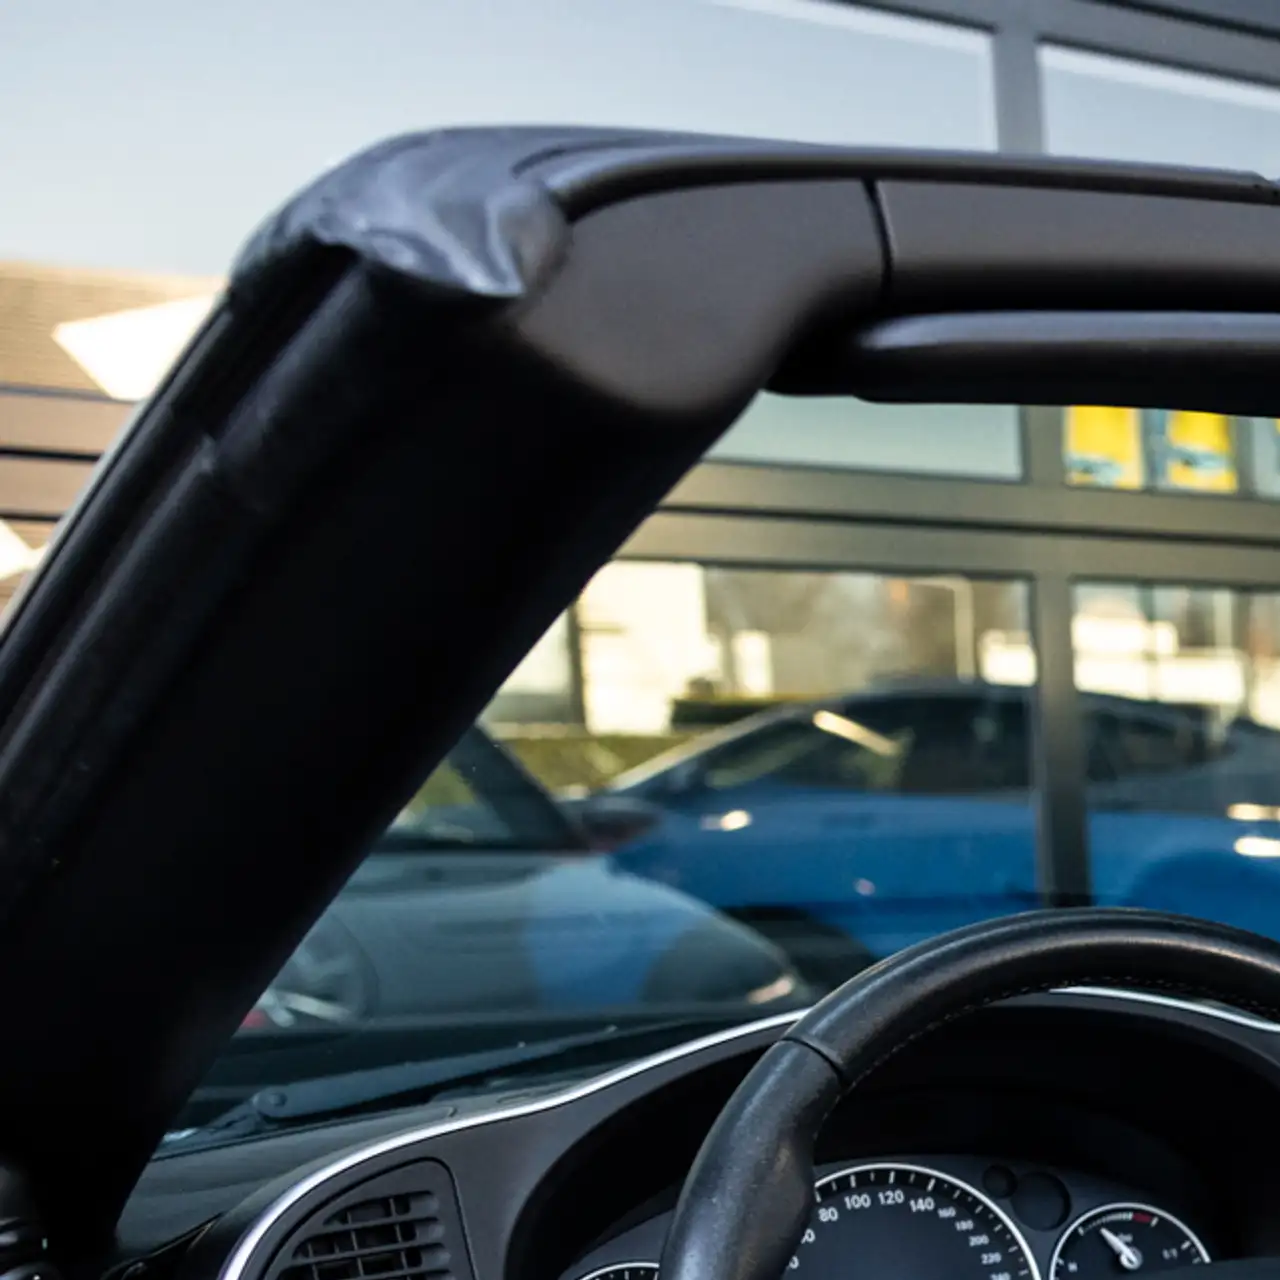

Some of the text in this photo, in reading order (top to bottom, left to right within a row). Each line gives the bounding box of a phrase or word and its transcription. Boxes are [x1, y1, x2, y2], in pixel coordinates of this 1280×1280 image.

[844, 1194, 872, 1209] 100
[878, 1189, 904, 1205] 120
[909, 1198, 935, 1212] 140
[818, 1207, 838, 1222] 80
[801, 1228, 815, 1244] 0
